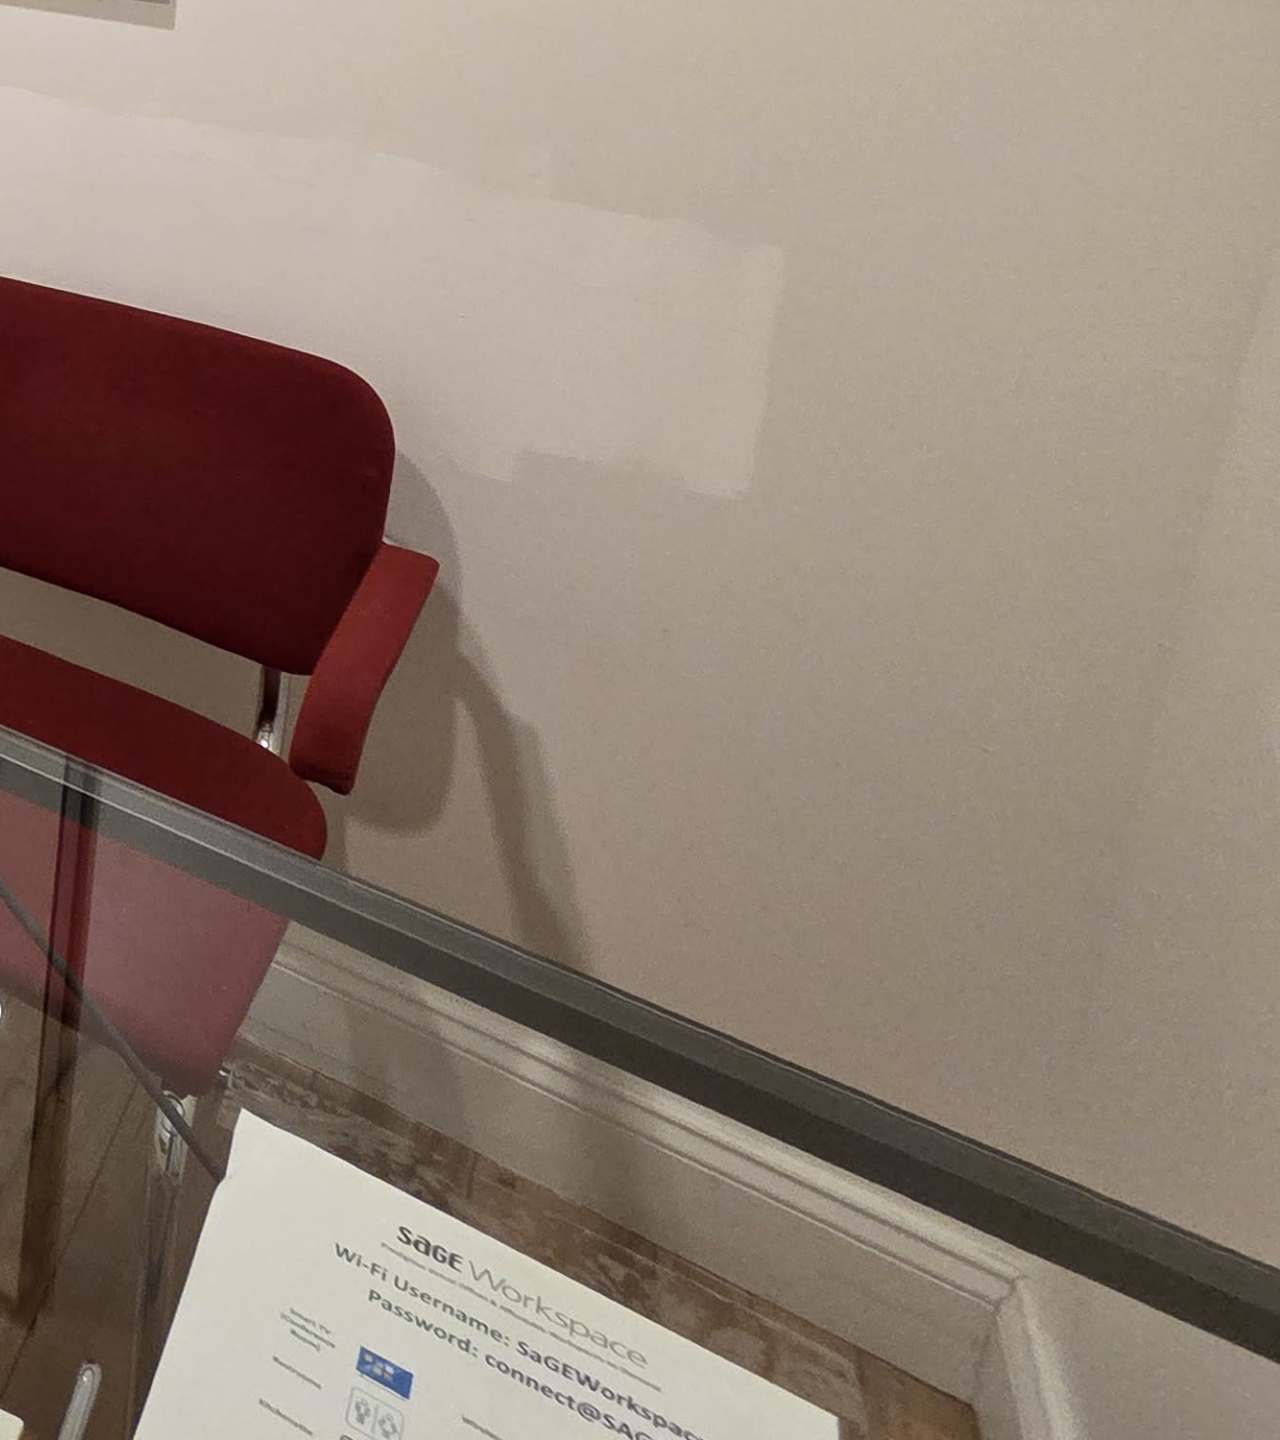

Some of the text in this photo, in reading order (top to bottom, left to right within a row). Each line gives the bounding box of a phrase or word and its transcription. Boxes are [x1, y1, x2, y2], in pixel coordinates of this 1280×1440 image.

[334, 1242, 388, 1282] Wi-Fi
[393, 1275, 511, 1347] Username:
[516, 1340, 704, 1440] SaGEWorkspac
[368, 1288, 479, 1358] Password:
[468, 1259, 649, 1371] Workspace
